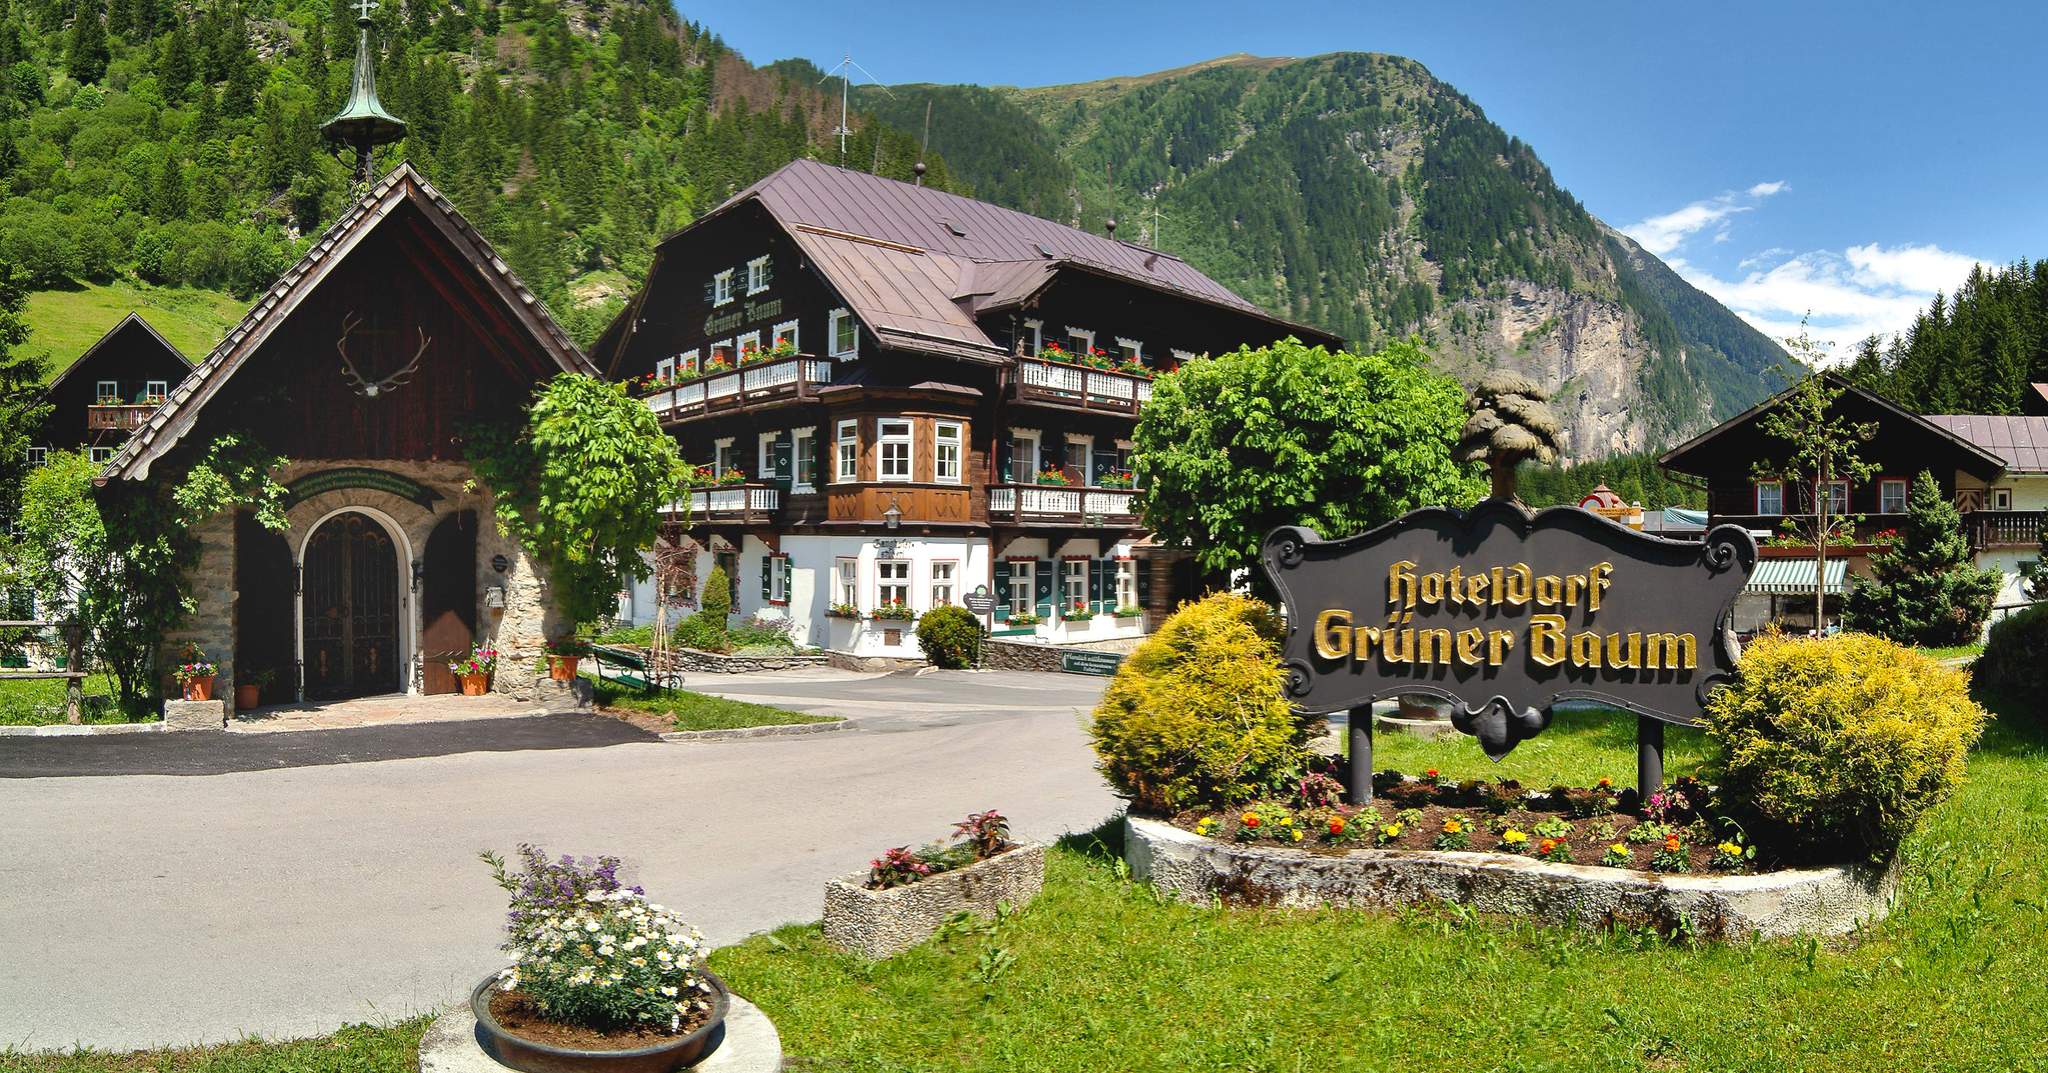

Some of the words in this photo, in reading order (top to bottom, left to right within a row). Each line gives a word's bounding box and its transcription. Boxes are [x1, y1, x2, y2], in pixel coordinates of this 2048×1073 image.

[744, 298, 782, 323] Baum
[1389, 560, 1613, 611] Hoteldorf
[1314, 608, 1514, 667] Grüner
[1530, 613, 1698, 670] Baum
